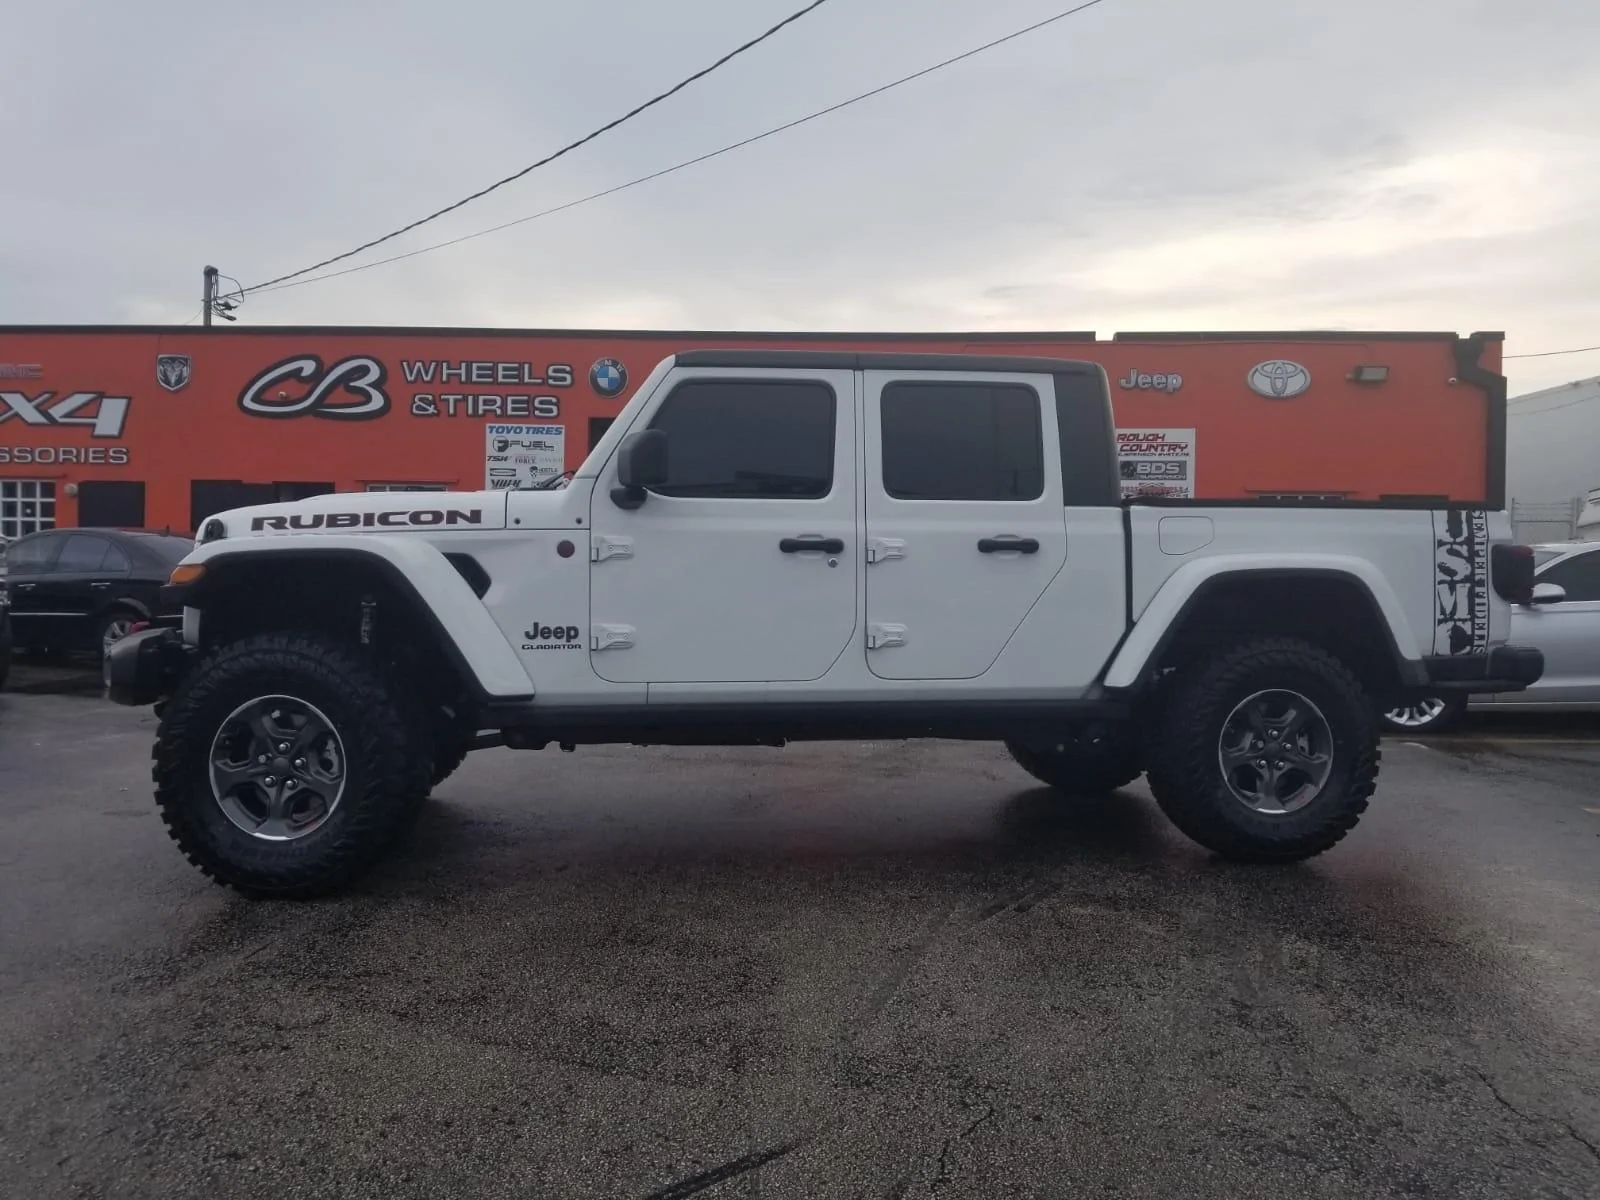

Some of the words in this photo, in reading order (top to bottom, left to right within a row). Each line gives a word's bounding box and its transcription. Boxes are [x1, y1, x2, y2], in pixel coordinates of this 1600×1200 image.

[401, 361, 574, 387] WHEELS
[1119, 369, 1184, 393] Jeep
[488, 425, 523, 434] TOYO
[525, 426, 563, 435] TIRES
[1116, 433, 1165, 442] ROUGH
[510, 440, 555, 448] FUEL
[1119, 443, 1188, 452] COUNTRY
[1136, 462, 1181, 474] BDS
[251, 509, 482, 531] RUBICON
[524, 622, 579, 643] Jeep
